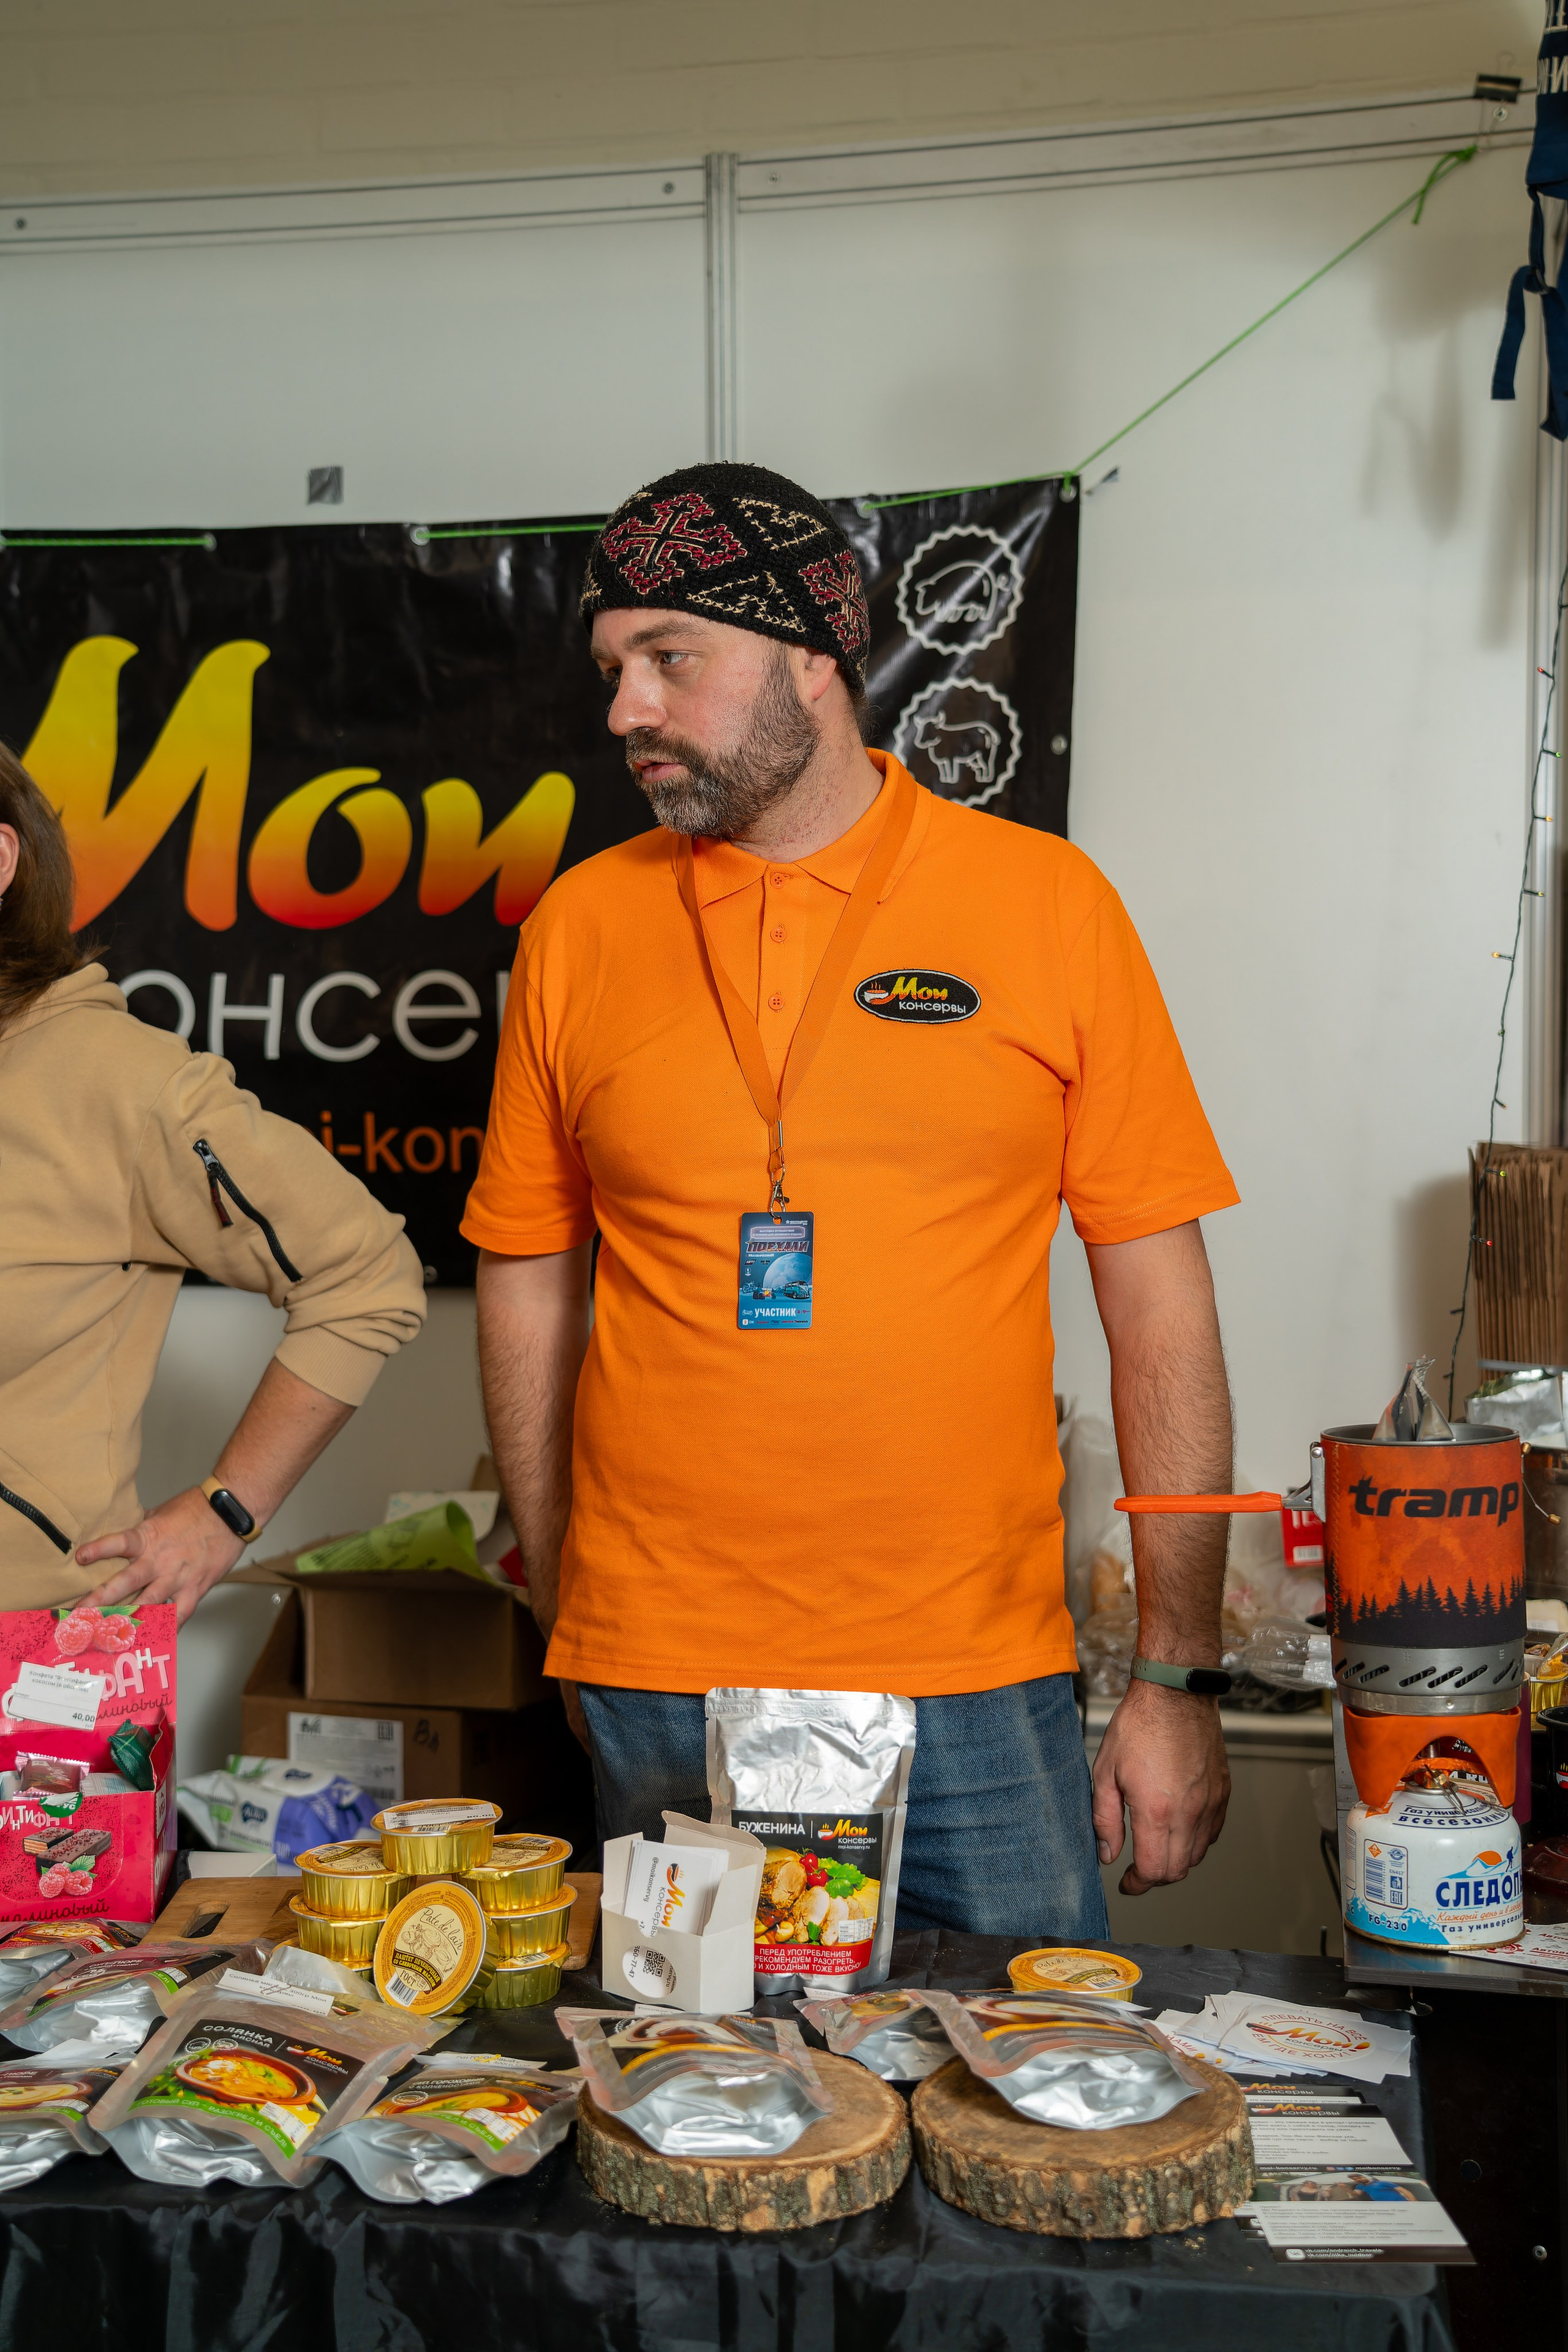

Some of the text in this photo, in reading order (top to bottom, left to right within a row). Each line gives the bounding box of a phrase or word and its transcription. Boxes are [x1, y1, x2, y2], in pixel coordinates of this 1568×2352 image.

[21, 634, 576, 932] Мои
[886, 976, 948, 1000] Мои
[121, 969, 507, 1062] онсе
[899, 1001, 966, 1014] консервы
[320, 1110, 484, 1175] i-kon
[746, 1240, 810, 1253] ПОЕХАЛИ
[755, 1308, 796, 1317] УЧАСТНИК
[1349, 1475, 1518, 1526] tramp
[29, 1670, 53, 1679] Конфета
[72, 1713, 95, 1722] 40,00
[739, 1821, 805, 1835] БУЖЕНИНА
[832, 1819, 868, 1838] Мои
[643, 1856, 659, 1902] @moikonservy
[420, 1906, 439, 1926] Pate
[650, 1887, 666, 1937] консервы
[662, 1888, 685, 1927] Мои
[1368, 1913, 1407, 1931] FG-230
[1436, 1911, 1477, 1923] Каждый
[1480, 1912, 1498, 1921] день
[760, 1948, 851, 1958] ПЕРЕД УПОТРЕБЛЕНИЕМ
[813, 1957, 855, 1966] РАЗОГРЕТЬ,
[89, 1959, 144, 1968] СУП-ПЮРЕ
[394, 1953, 440, 1983] ПАШТЕТ ПЕЧЕНОЧНЫЙ
[835, 1962, 862, 1973] ВКУСНО!
[229, 1973, 259, 1983] Солянка
[399, 1960, 423, 1973] СЛИВОЧНЫМ
[423, 1970, 437, 1988] МАСЛОМ
[399, 1970, 417, 1987] ГОСТ
[1262, 2014, 1323, 2024] ПЛЕВАТЬ
[1327, 2022, 1345, 2030] НА
[203, 2025, 273, 2045] СОЛЯНКА
[232, 2034, 271, 2048] МЯСНАЯ
[1252, 2033, 1271, 2043] ЕМ
[1268, 2043, 1298, 2056] ГДЕ
[1286, 2038, 1343, 2052] консервы
[304, 2048, 343, 2066] Мои
[306, 2056, 349, 2075] консервы
[416, 2081, 481, 2089] КОПЧЕНОСТЯМИ
[137, 2098, 180, 2106] ГОТОВЫЙ
[208, 2106, 255, 2122] РАЗОГРЕЛ
[265, 2125, 287, 2148] СЪЕЛ!
